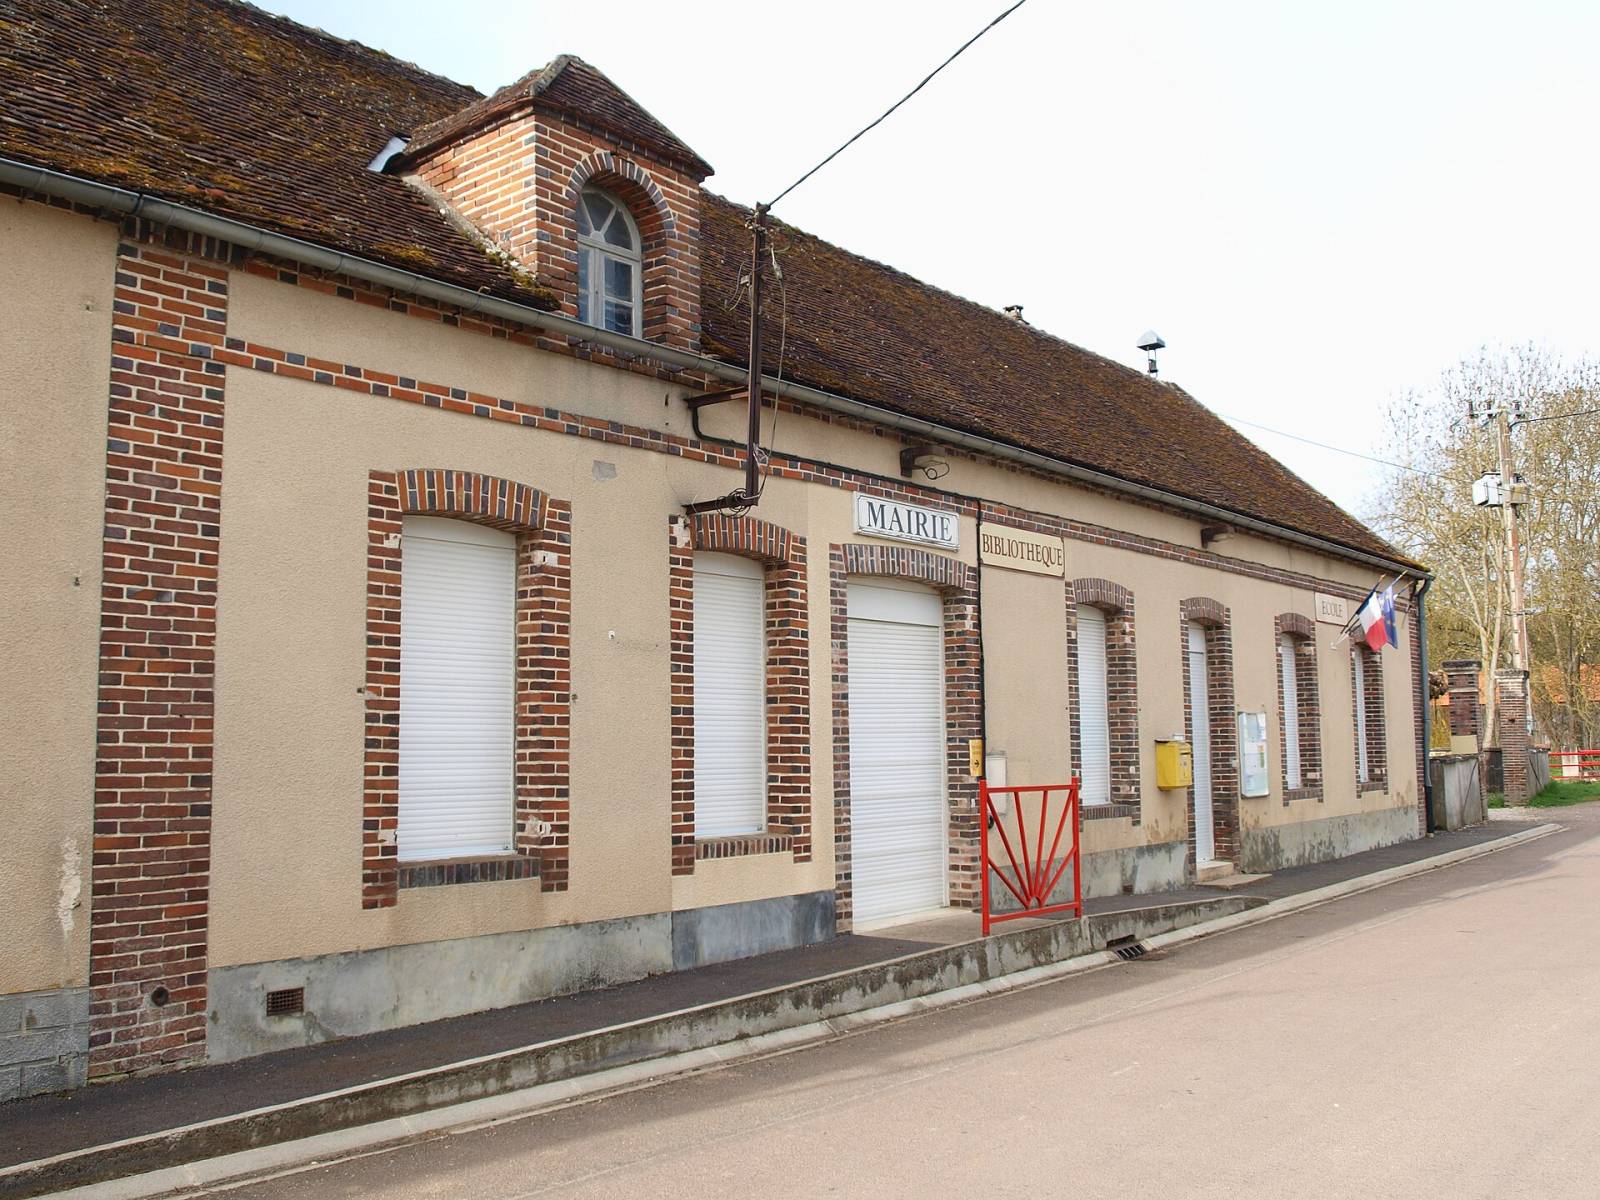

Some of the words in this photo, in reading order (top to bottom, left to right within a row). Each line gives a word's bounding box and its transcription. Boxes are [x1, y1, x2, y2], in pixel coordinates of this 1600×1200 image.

[867, 501, 952, 541] MAIRIE
[982, 533, 1062, 567] BIBLIOTHEQUE
[1322, 601, 1343, 618] ECOLE
